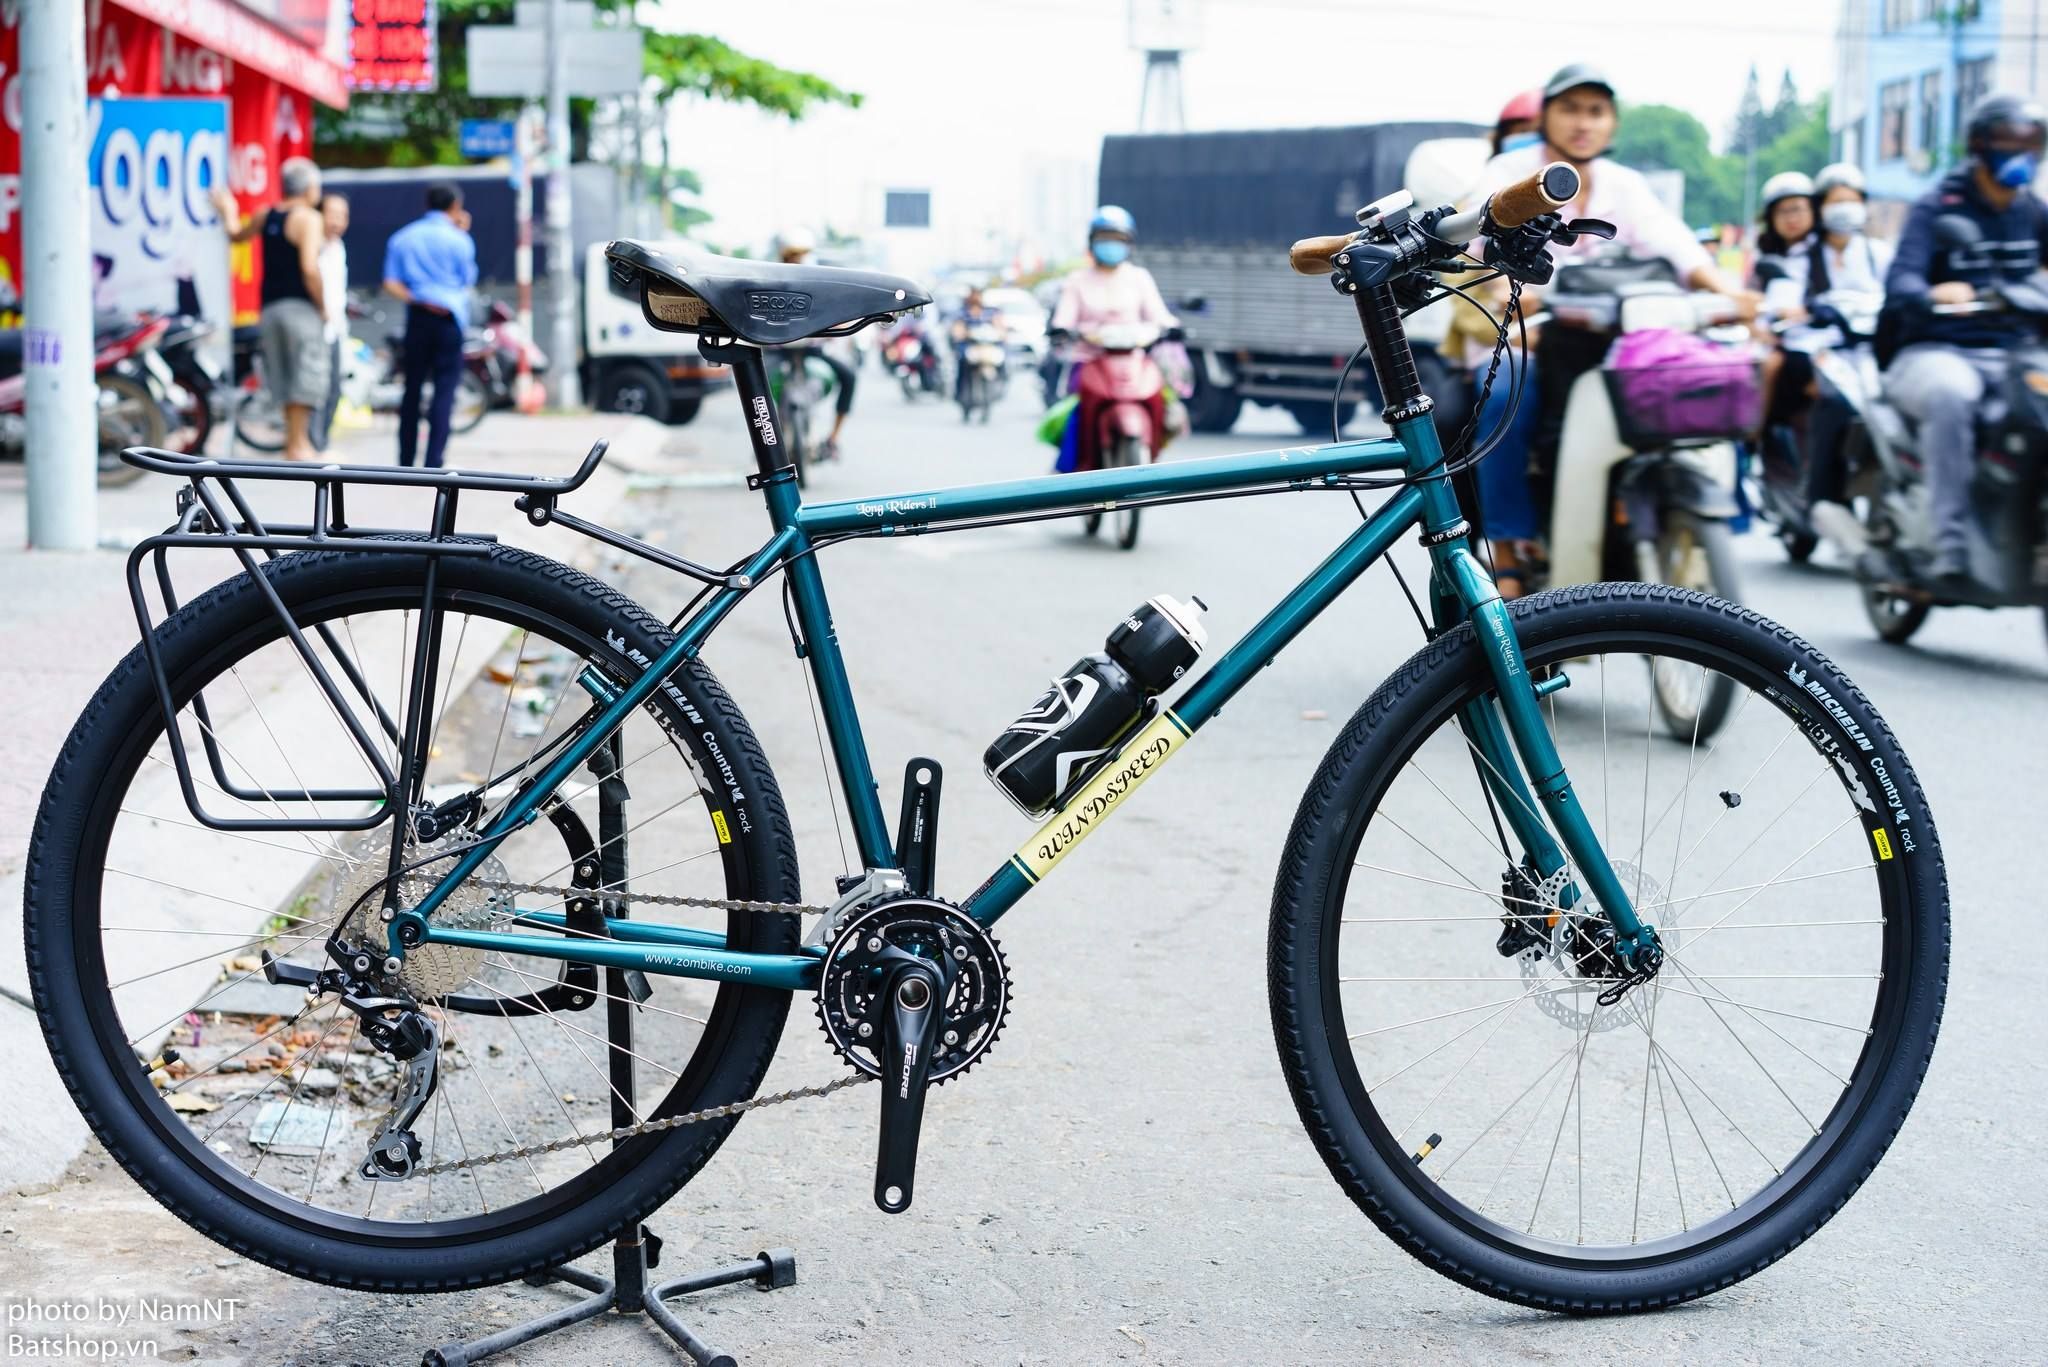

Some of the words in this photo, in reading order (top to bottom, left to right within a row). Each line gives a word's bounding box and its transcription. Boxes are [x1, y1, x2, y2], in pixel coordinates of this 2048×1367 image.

[86, 98, 228, 260] oga
[751, 295, 806, 309] BROOKS
[755, 395, 777, 446] TRUVATIV
[1393, 410, 1406, 420] VP
[856, 503, 884, 517] Long
[886, 499, 926, 515] Riders
[1431, 533, 1444, 542] VP
[1491, 613, 1506, 638] Long
[1498, 634, 1517, 668] Riders
[702, 732, 738, 785] Country
[737, 808, 753, 833] rock
[1805, 680, 1874, 752] MICHELIN
[1870, 757, 1902, 808] Country
[1900, 828, 1917, 853] rock
[1038, 736, 1171, 860] WINDSPEED
[644, 953, 752, 975] www.zombike.com
[900, 1042, 913, 1099] DEORE
